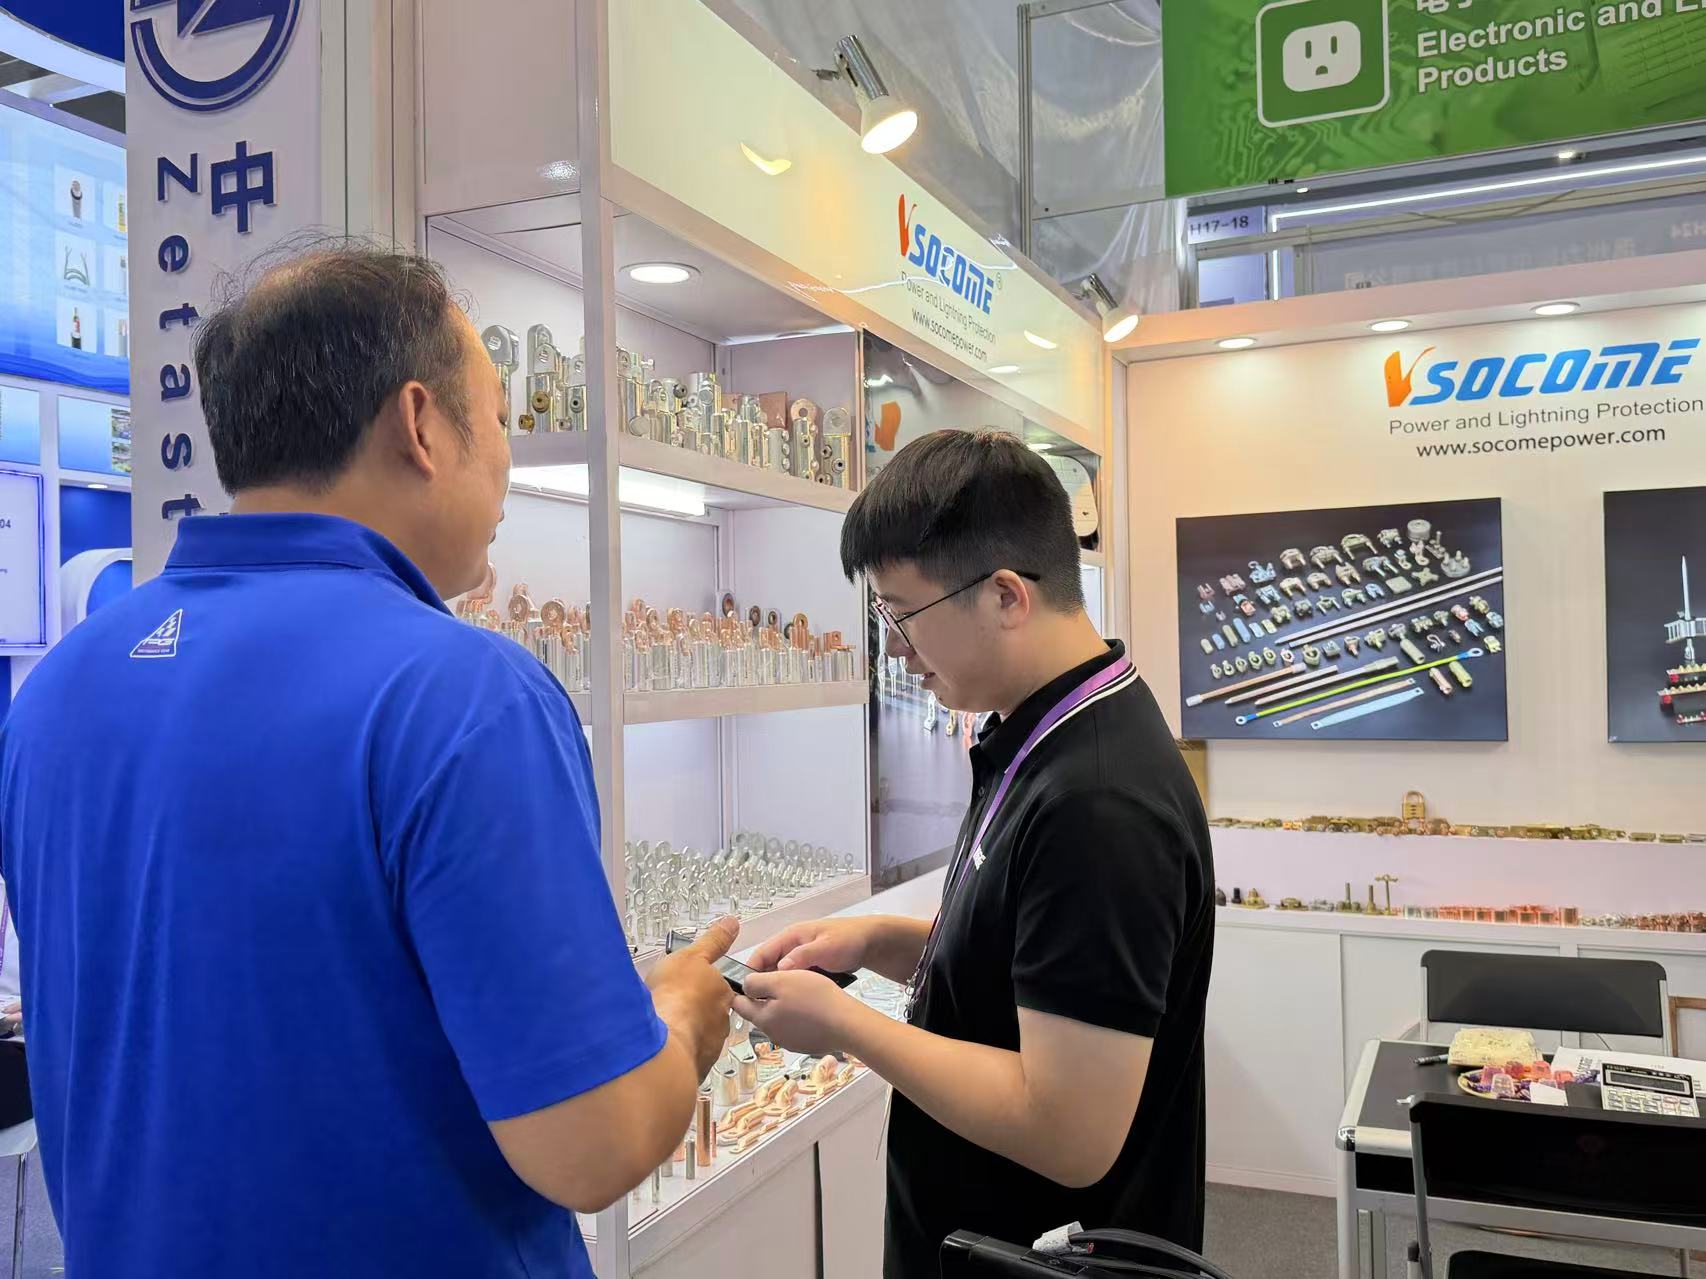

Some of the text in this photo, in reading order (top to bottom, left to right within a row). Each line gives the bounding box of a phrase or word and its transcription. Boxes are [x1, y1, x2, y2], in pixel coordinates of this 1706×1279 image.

[1417, 8, 1586, 58] Electronic
[1597, 0, 1662, 26] and
[1418, 48, 1568, 93] Products
[210, 140, 278, 234] 中
[1190, 215, 1249, 236] H17-18
[912, 308, 988, 363] www.socomepower.com
[925, 289, 939, 309] and
[938, 298, 968, 330] Lightning
[968, 314, 996, 345] Protection
[1389, 397, 1705, 435] Power and Lightning Protection
[1416, 427, 1666, 457] www.socomepower.com
